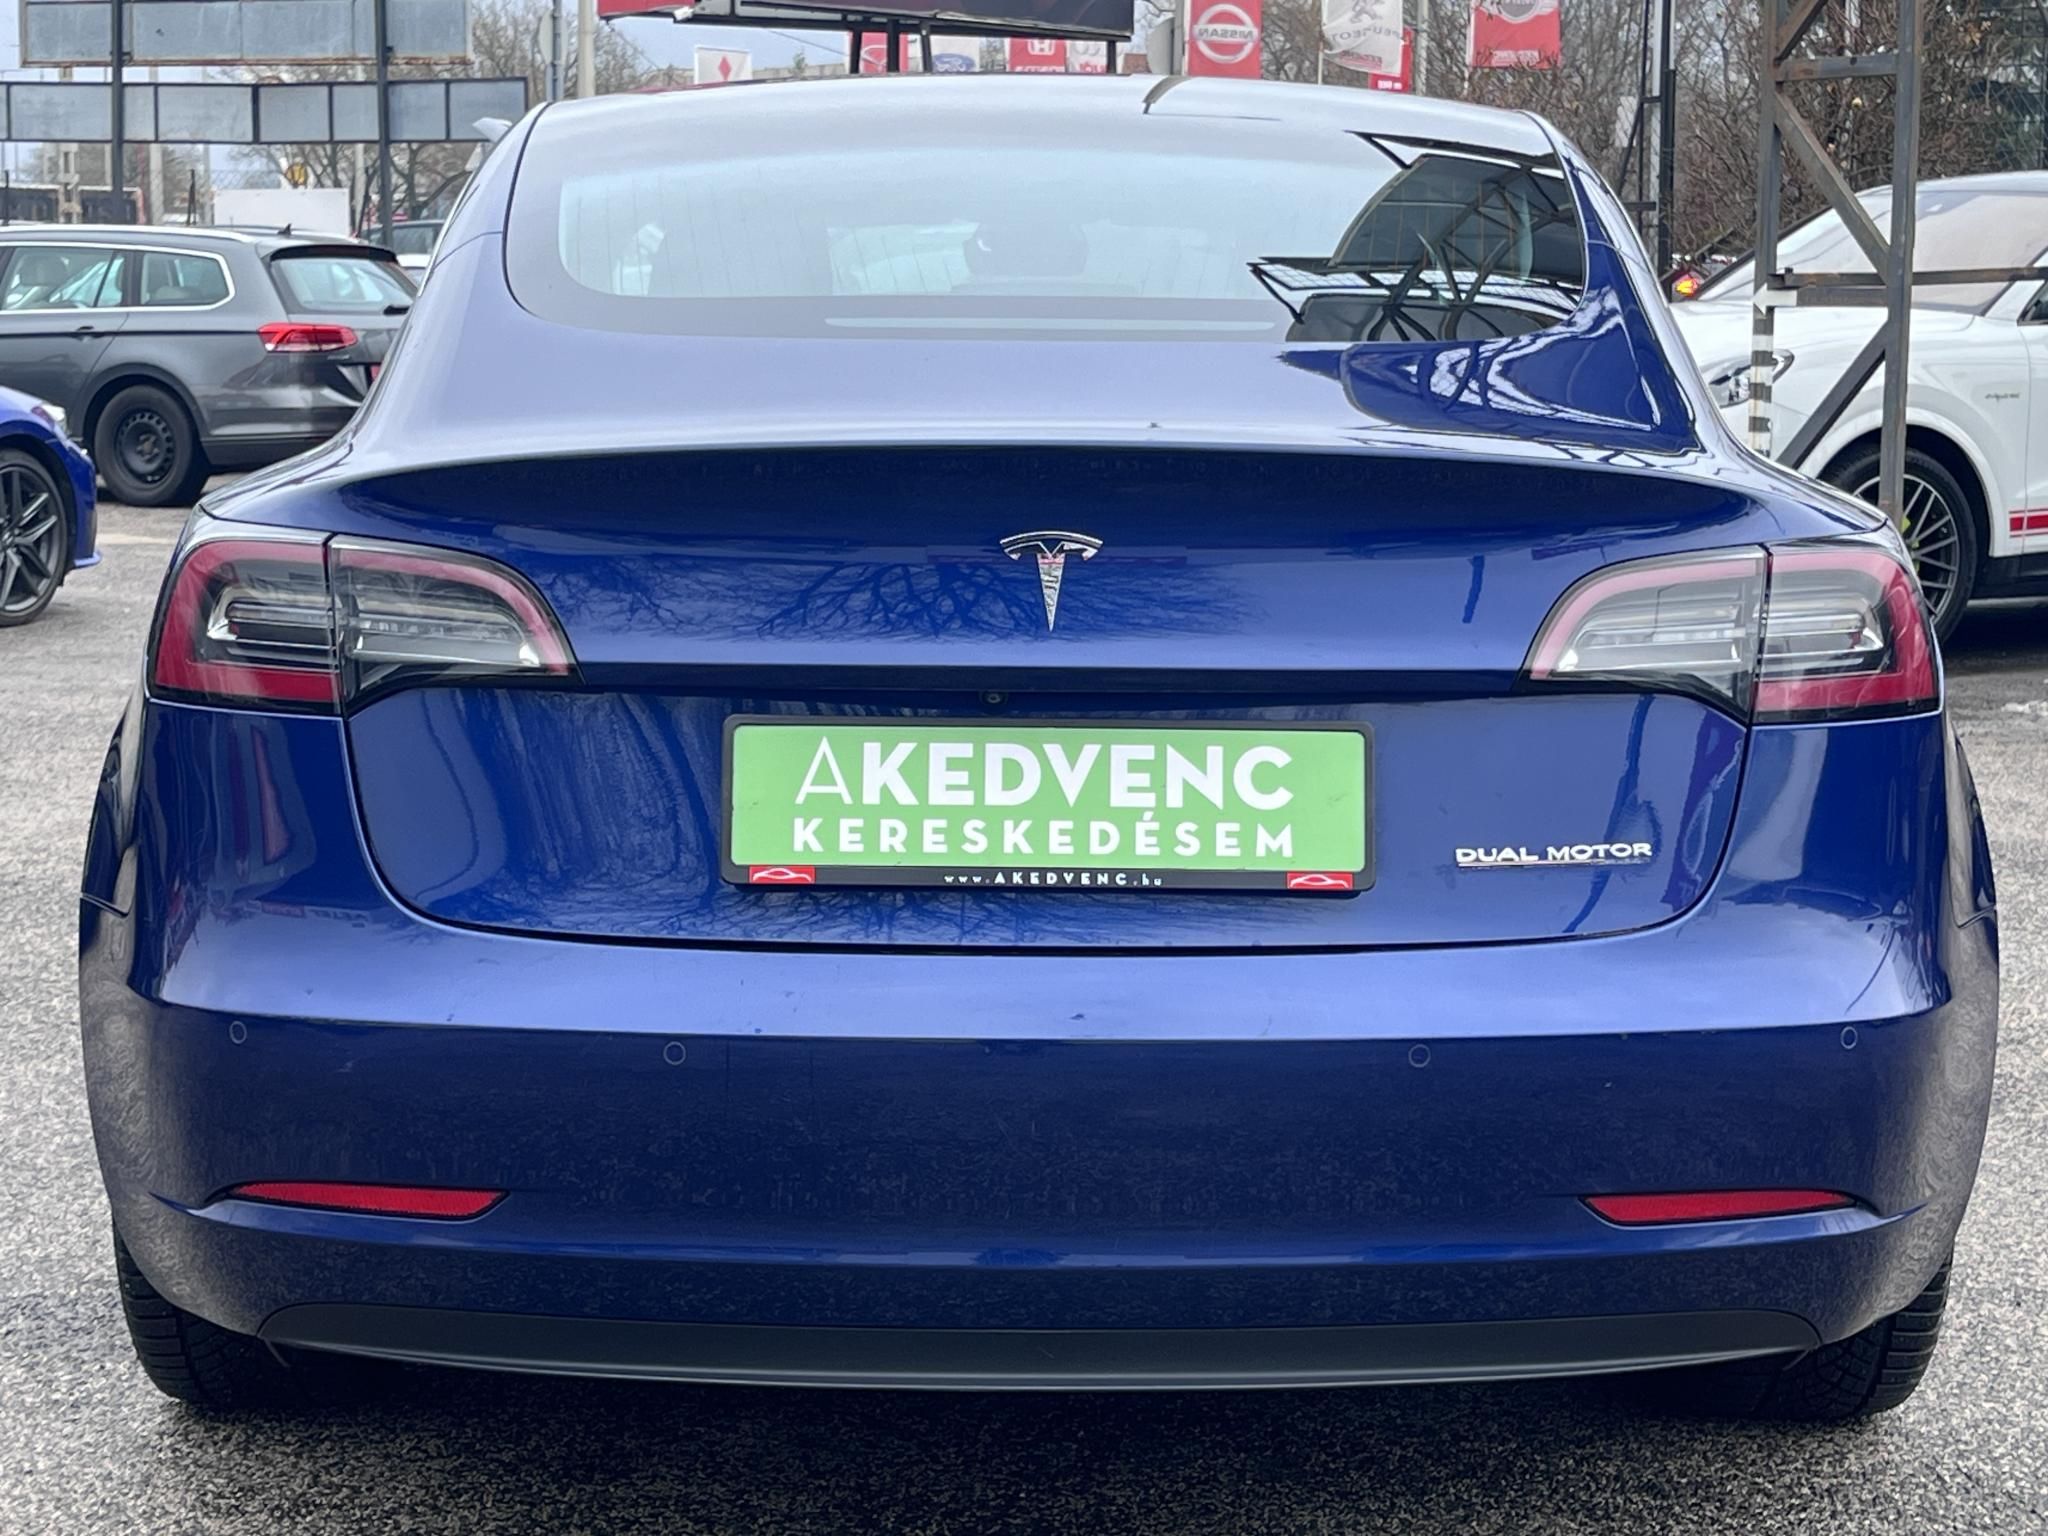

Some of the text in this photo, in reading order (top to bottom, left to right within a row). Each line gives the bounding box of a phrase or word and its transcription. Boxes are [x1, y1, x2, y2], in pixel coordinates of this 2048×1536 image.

[795, 736, 1294, 811] AKEDVENC
[793, 811, 1294, 858] KERESKEDÉSEM
[1455, 842, 1653, 863] DUAL MOTOR
[944, 871, 1163, 887] www.AKEDVENC.hu
